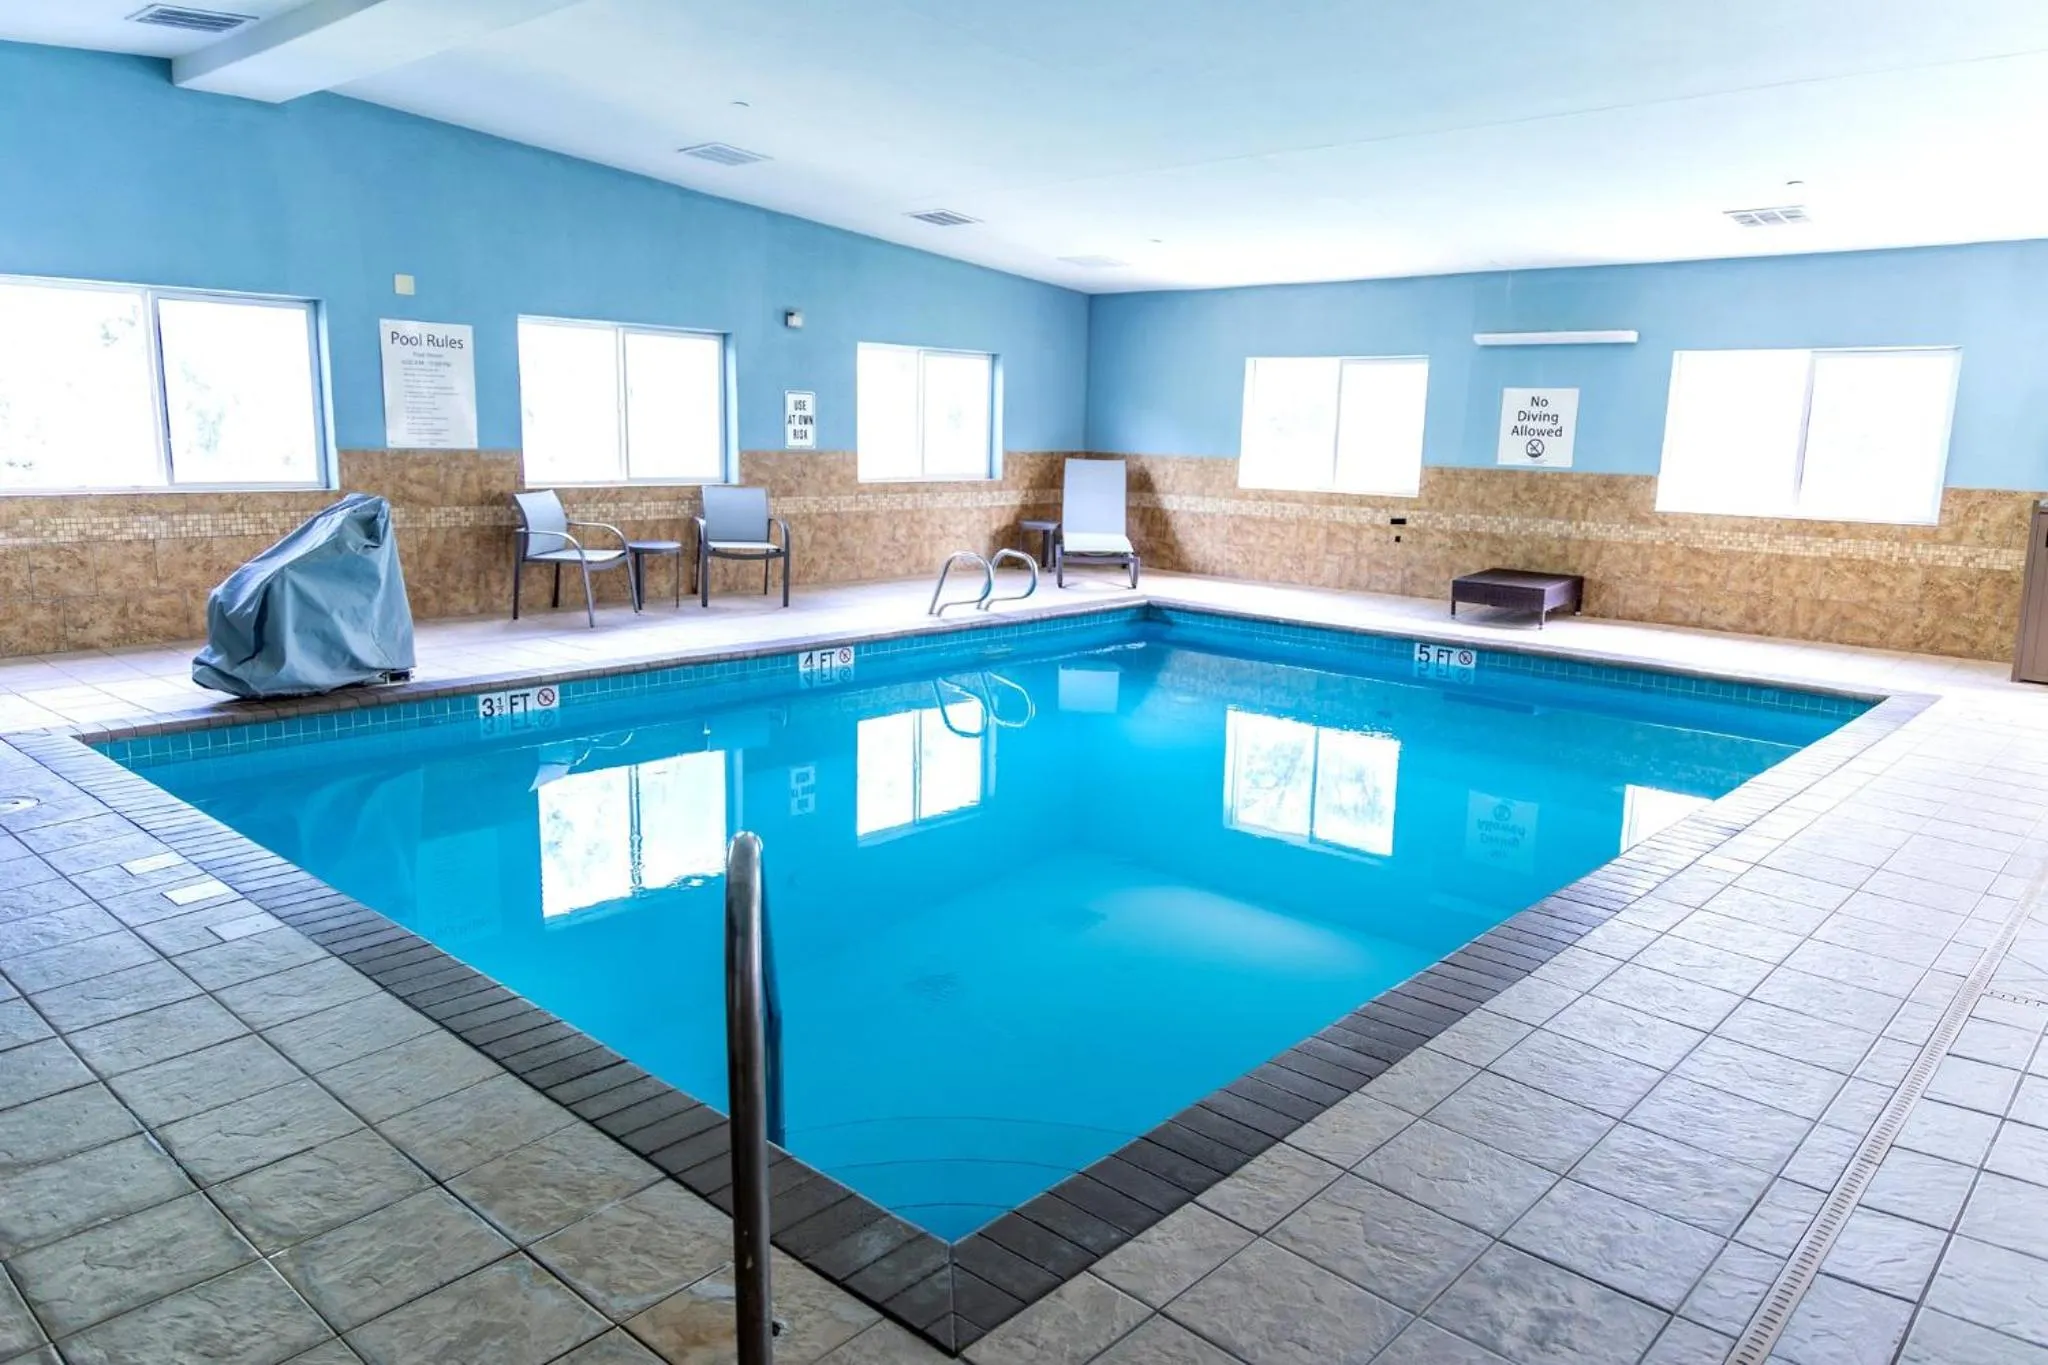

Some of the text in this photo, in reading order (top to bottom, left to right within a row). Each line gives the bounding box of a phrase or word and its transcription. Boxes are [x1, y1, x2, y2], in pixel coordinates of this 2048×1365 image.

[391, 330, 464, 350] Pool Rules
[793, 399, 807, 411] USE
[1530, 395, 1549, 408] No
[788, 414, 813, 426] AT OWN
[1517, 409, 1559, 426] Diving
[793, 428, 808, 440] RISK
[1511, 424, 1563, 438] Allowed
[802, 651, 835, 670] 4 FT
[1418, 643, 1454, 665] 5 FT
[509, 692, 530, 714] FT
